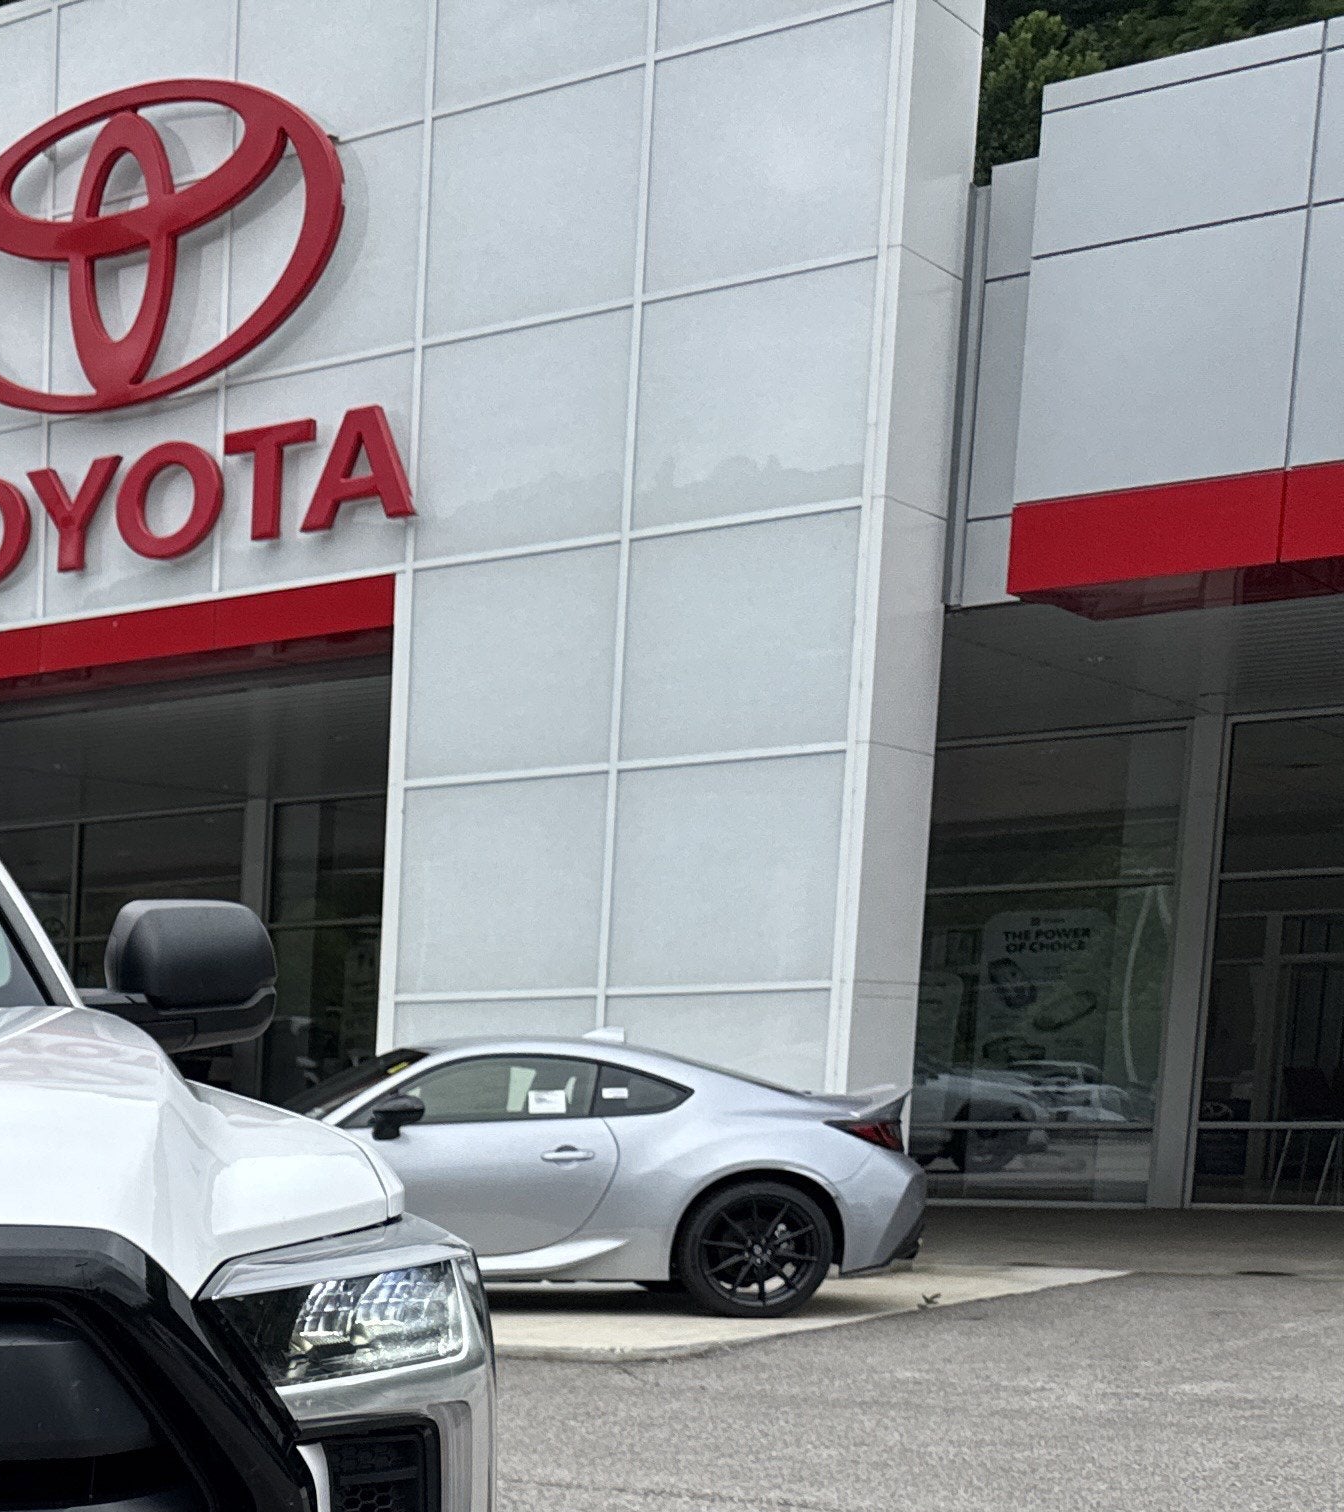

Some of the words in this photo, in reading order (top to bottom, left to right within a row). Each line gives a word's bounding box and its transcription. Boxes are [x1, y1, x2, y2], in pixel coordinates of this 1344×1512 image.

[1003, 930, 1030, 941] THE
[1035, 927, 1091, 938] POWER
[1006, 942, 1026, 953] OF
[1029, 940, 1085, 952] CHOICE
